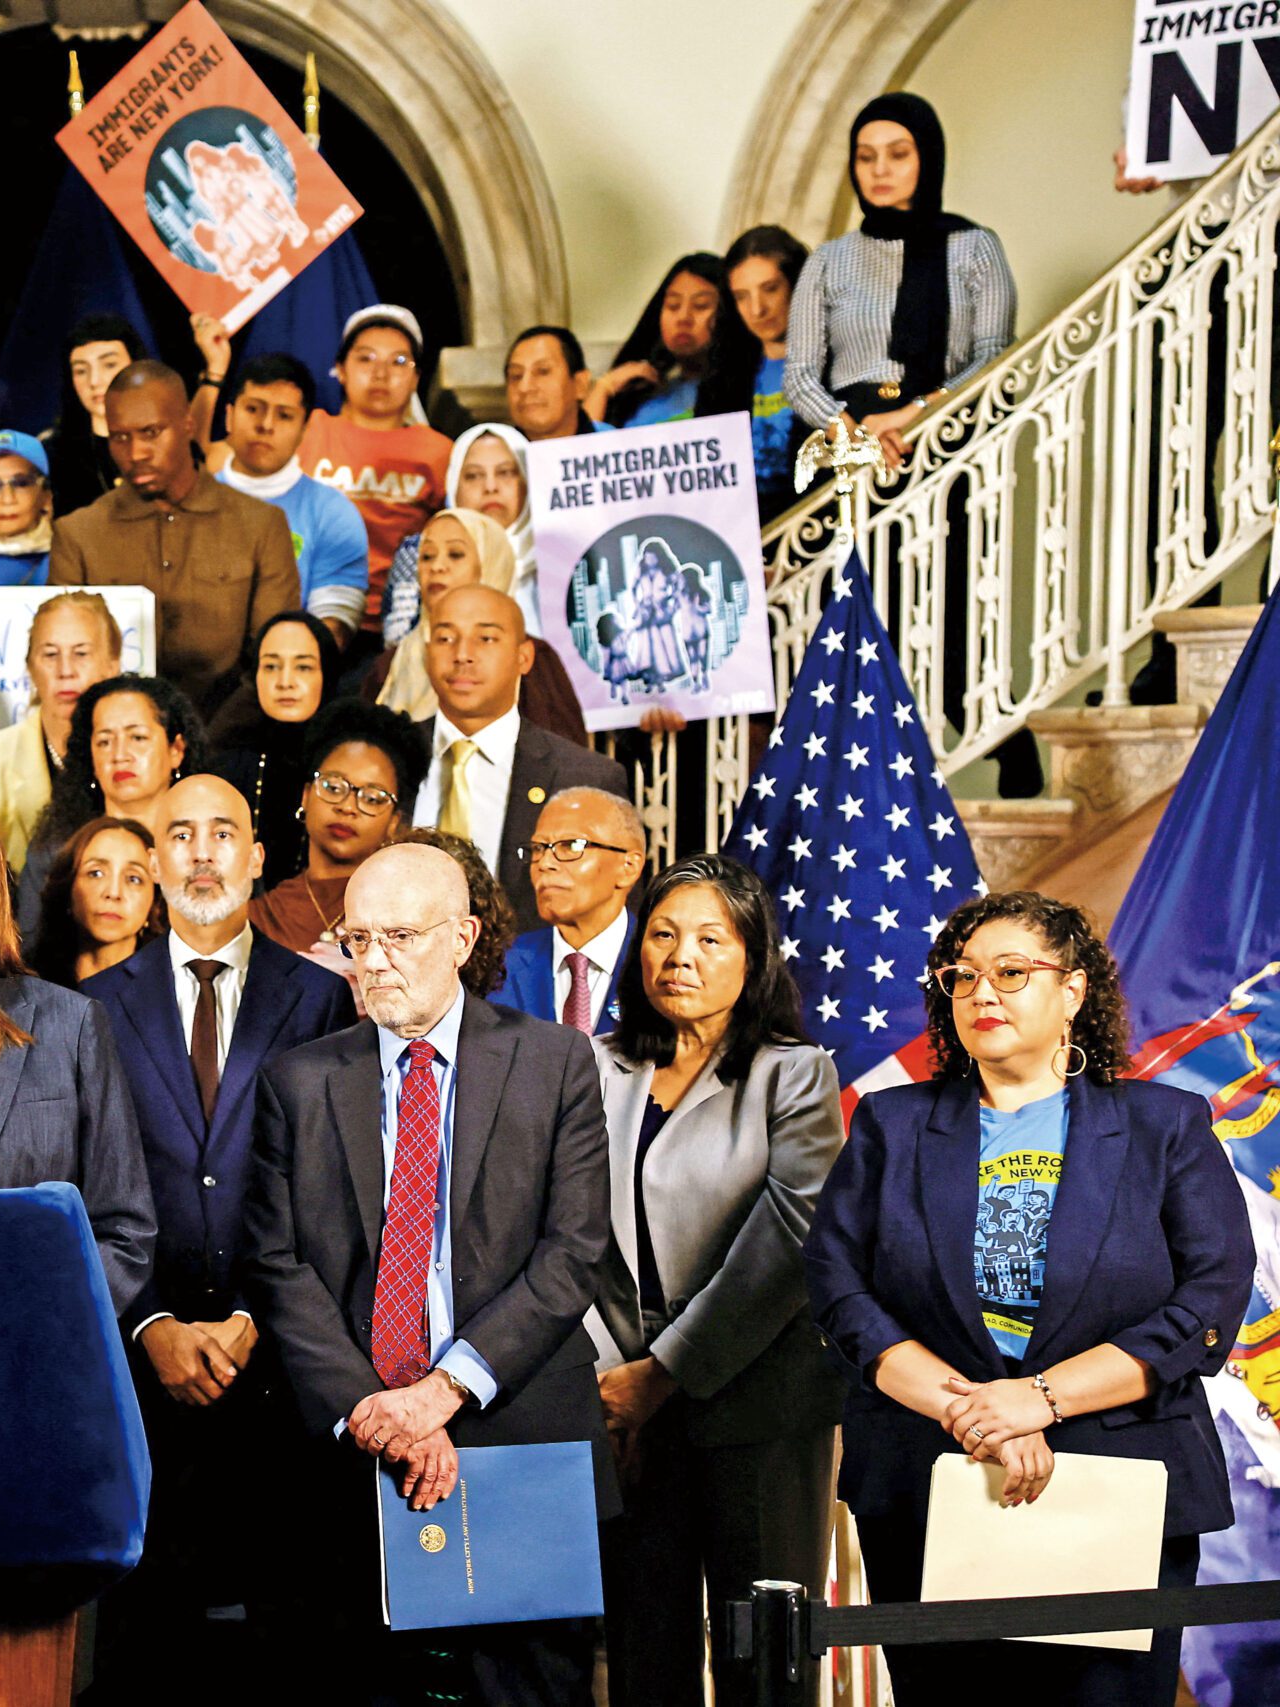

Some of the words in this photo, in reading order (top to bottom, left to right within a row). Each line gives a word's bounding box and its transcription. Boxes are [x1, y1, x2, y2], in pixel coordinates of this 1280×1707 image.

[87, 37, 196, 148] IMMIGRANTS
[98, 140, 133, 174] ARE
[129, 97, 170, 141] NEW
[167, 45, 223, 100] YORK!
[560, 438, 721, 482] IMMIGRANTS
[550, 484, 594, 510] ARE
[602, 475, 655, 503] NEW
[663, 463, 738, 495] YORK!
[997, 1154, 1033, 1168] THE
[1010, 1168, 1043, 1178] NEW
